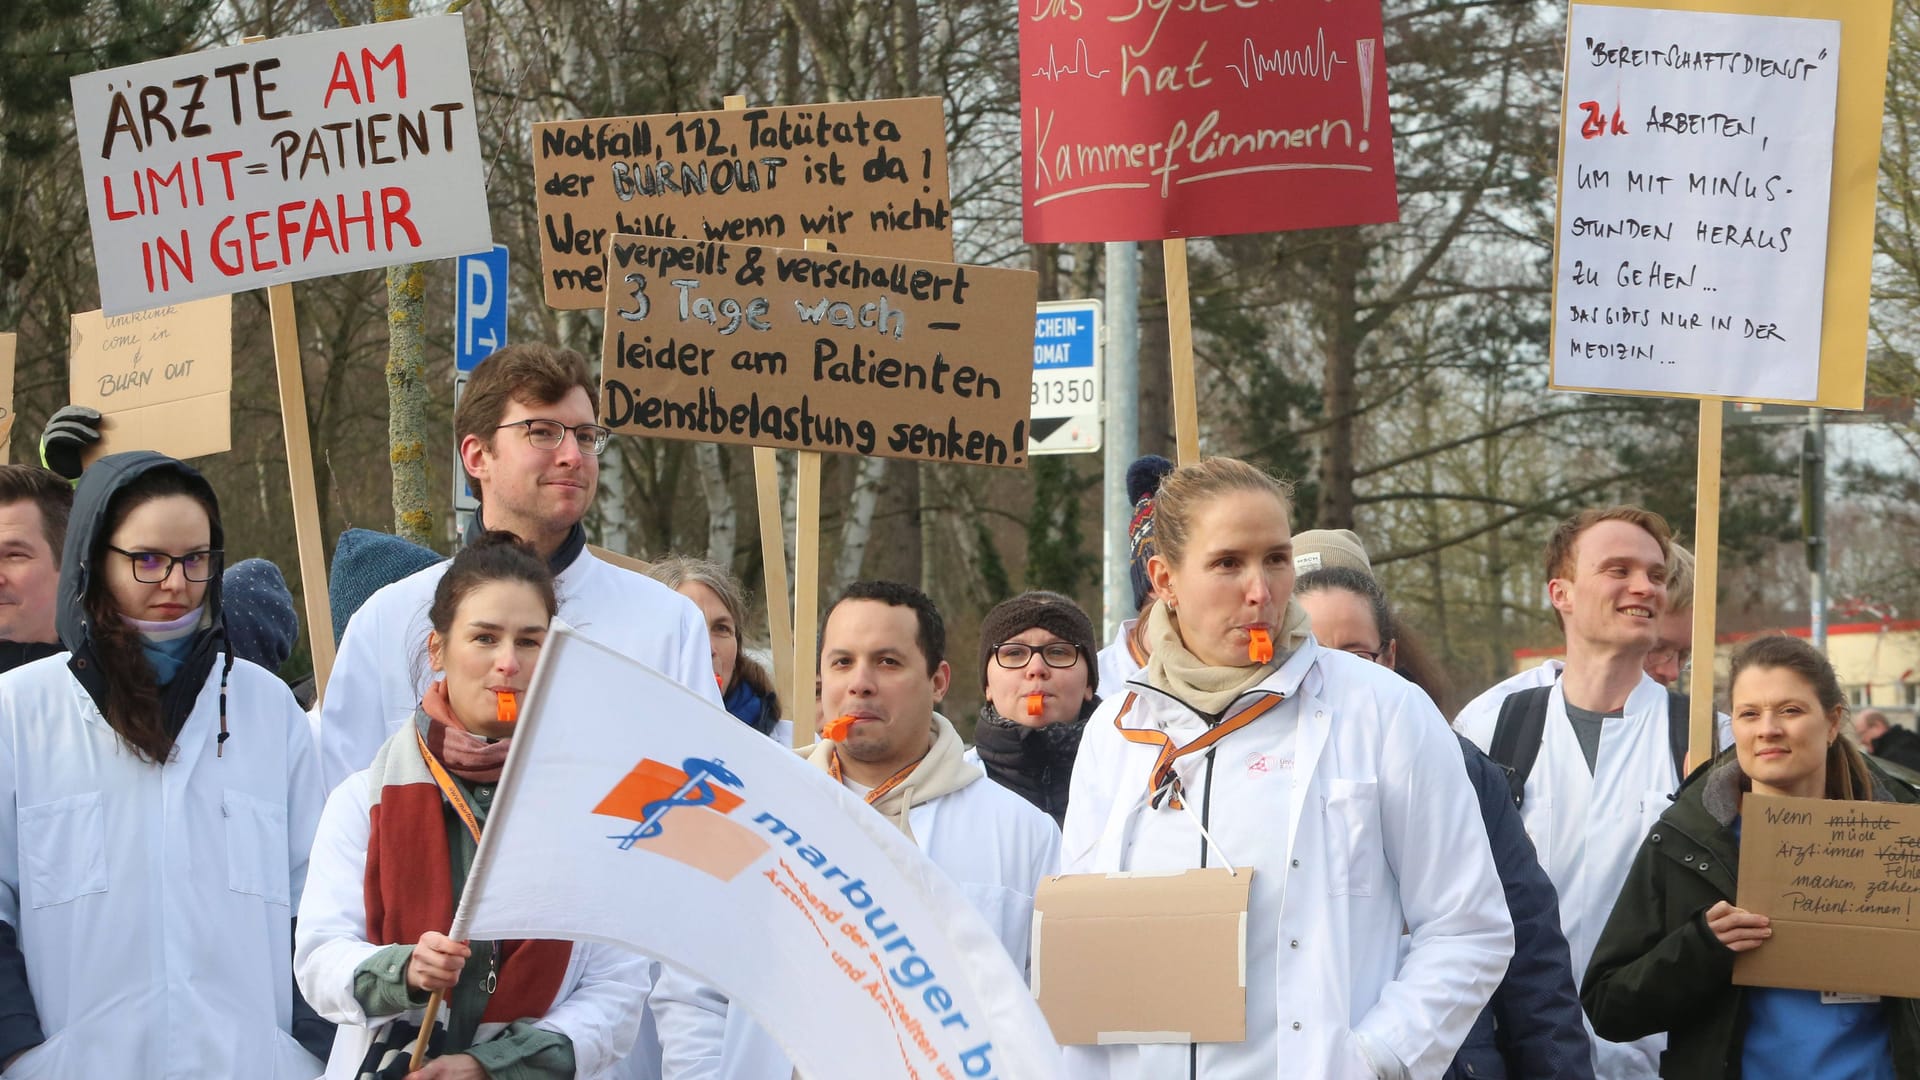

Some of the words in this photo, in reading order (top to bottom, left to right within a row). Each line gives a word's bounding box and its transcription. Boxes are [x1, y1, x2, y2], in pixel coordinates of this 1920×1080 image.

[1121, 40, 1212, 96] hat
[101, 57, 292, 160] ÄRZTE
[324, 44, 408, 108] AM
[542, 121, 661, 161] Notfall,
[665, 118, 737, 155] 112,
[743, 110, 901, 150] Tatütata
[1647, 106, 1767, 151] ARBEITEN,
[544, 172, 594, 197] der
[612, 157, 787, 201] BURNOUT
[804, 155, 844, 185] ist
[1577, 164, 1610, 190] UM
[1628, 172, 1675, 194] MIT
[142, 230, 193, 293] IN
[210, 187, 422, 276] GEFAHR
[546, 213, 606, 255] Wer
[702, 213, 785, 241] wenn
[800, 205, 853, 235] wir
[871, 198, 950, 232] nicht
[1571, 219, 1673, 241] STUNDEN
[1697, 221, 1792, 253] HERAUS
[614, 240, 730, 278] verpeilt
[735, 246, 766, 287] &
[1572, 261, 1600, 287] ZU
[465, 258, 493, 356] P
[617, 274, 650, 322] 3
[671, 279, 772, 336] Tage
[795, 293, 905, 340] wach
[1035, 317, 1085, 338] CHEIN-
[1570, 305, 1599, 324] DAS
[1606, 307, 1649, 327] GIBTS
[1661, 311, 1702, 329] NUR
[1712, 315, 1731, 330] IN
[1744, 318, 1786, 342] DER
[102, 334, 142, 351] come
[149, 327, 170, 342] in
[97, 368, 153, 397] BURN
[165, 359, 195, 380] OUT
[617, 331, 715, 376] leider
[731, 349, 787, 375] am
[813, 339, 1001, 400] Patienten
[604, 380, 876, 454] Dienstbelastung
[887, 417, 1025, 465] senken!
[1765, 807, 1812, 825] Wenn
[752, 811, 968, 1031] marburger
[958, 1041, 1000, 1080] b
[840, 923, 869, 949] der
[831, 950, 866, 983] und
